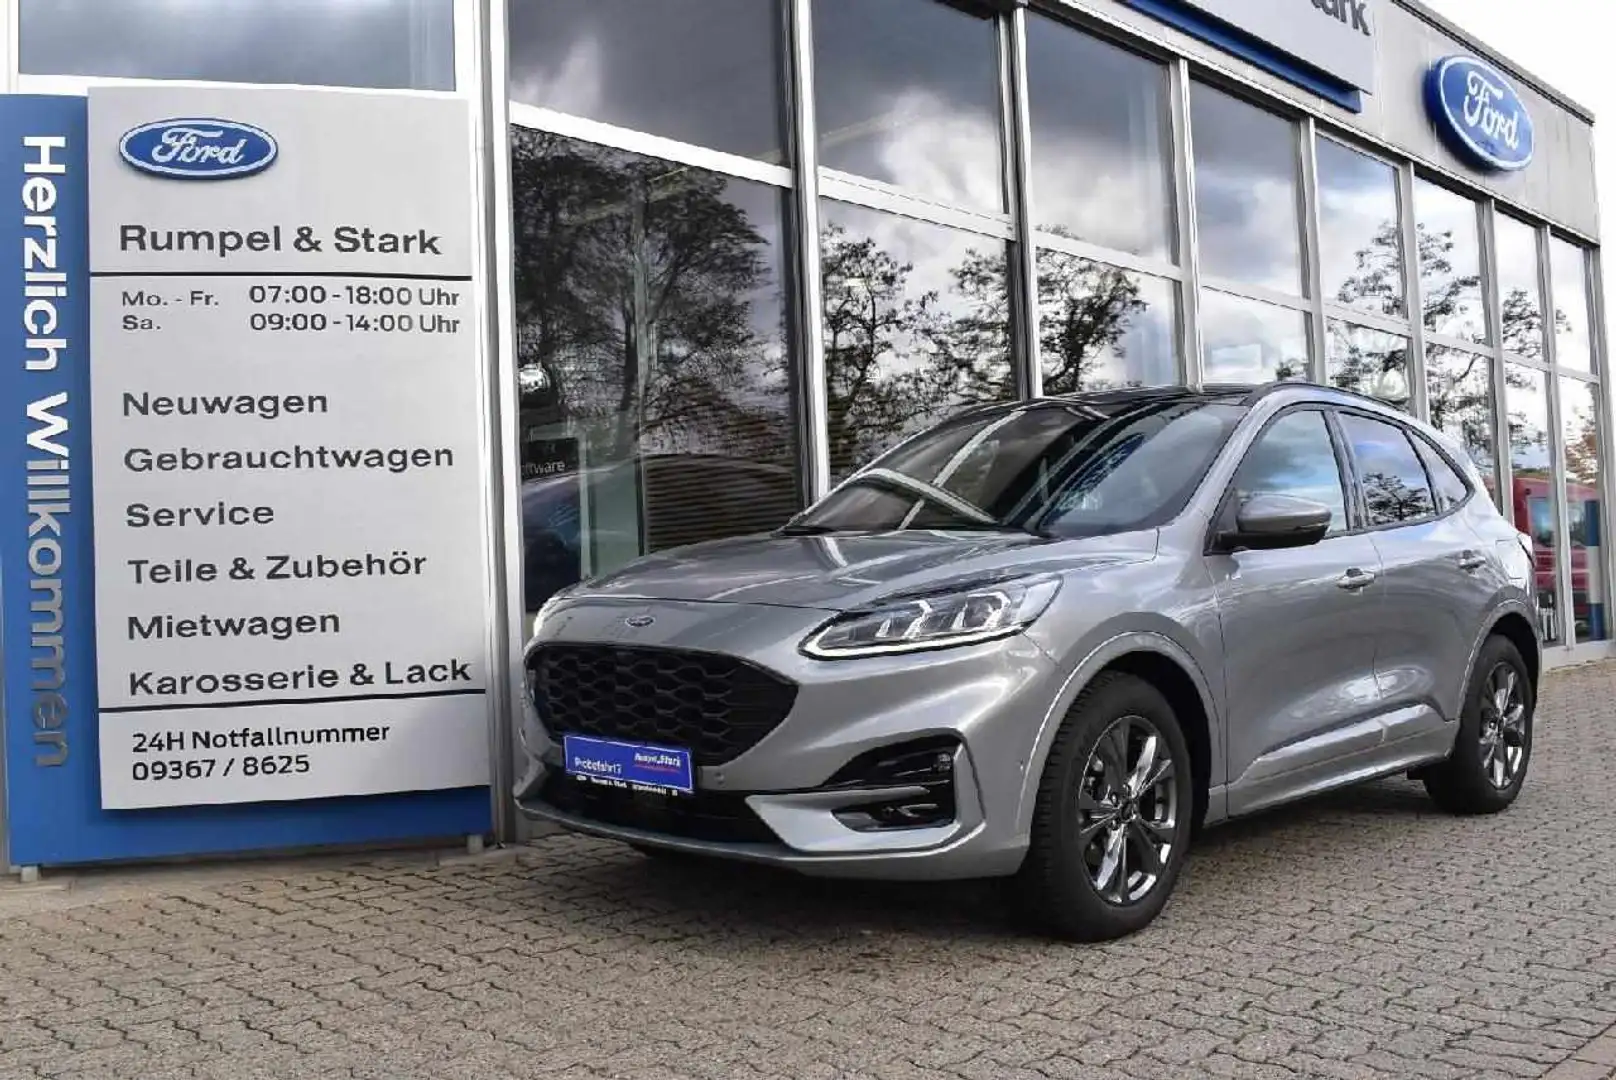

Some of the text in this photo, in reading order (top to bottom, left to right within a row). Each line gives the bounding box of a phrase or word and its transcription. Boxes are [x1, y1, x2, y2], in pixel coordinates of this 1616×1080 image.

[1464, 70, 1520, 150] Ford
[151, 127, 246, 165] Ford
[120, 224, 442, 257] Rumpel & Stark
[122, 291, 168, 307] Mo.
[190, 291, 219, 307] Fr.
[249, 286, 326, 305] 07:00
[346, 287, 412, 306] 18:00
[418, 289, 460, 307] Uhr
[122, 315, 161, 331] Sa.
[249, 313, 326, 332] 09:00
[346, 314, 413, 333] 14:00
[419, 314, 460, 333] Uhr
[123, 391, 328, 418] Neuwagen
[22, 135, 71, 767] Herzlich Willkommen
[124, 444, 454, 473] Gebrauchtwagen
[126, 501, 275, 528] Service
[128, 551, 427, 584] Teile & Zubehör
[128, 613, 340, 641] Mietwagen
[130, 658, 472, 695] Karosserie & Lack
[132, 724, 391, 753] 24H Notfallnummer
[132, 754, 310, 781] 09367 / 8625
